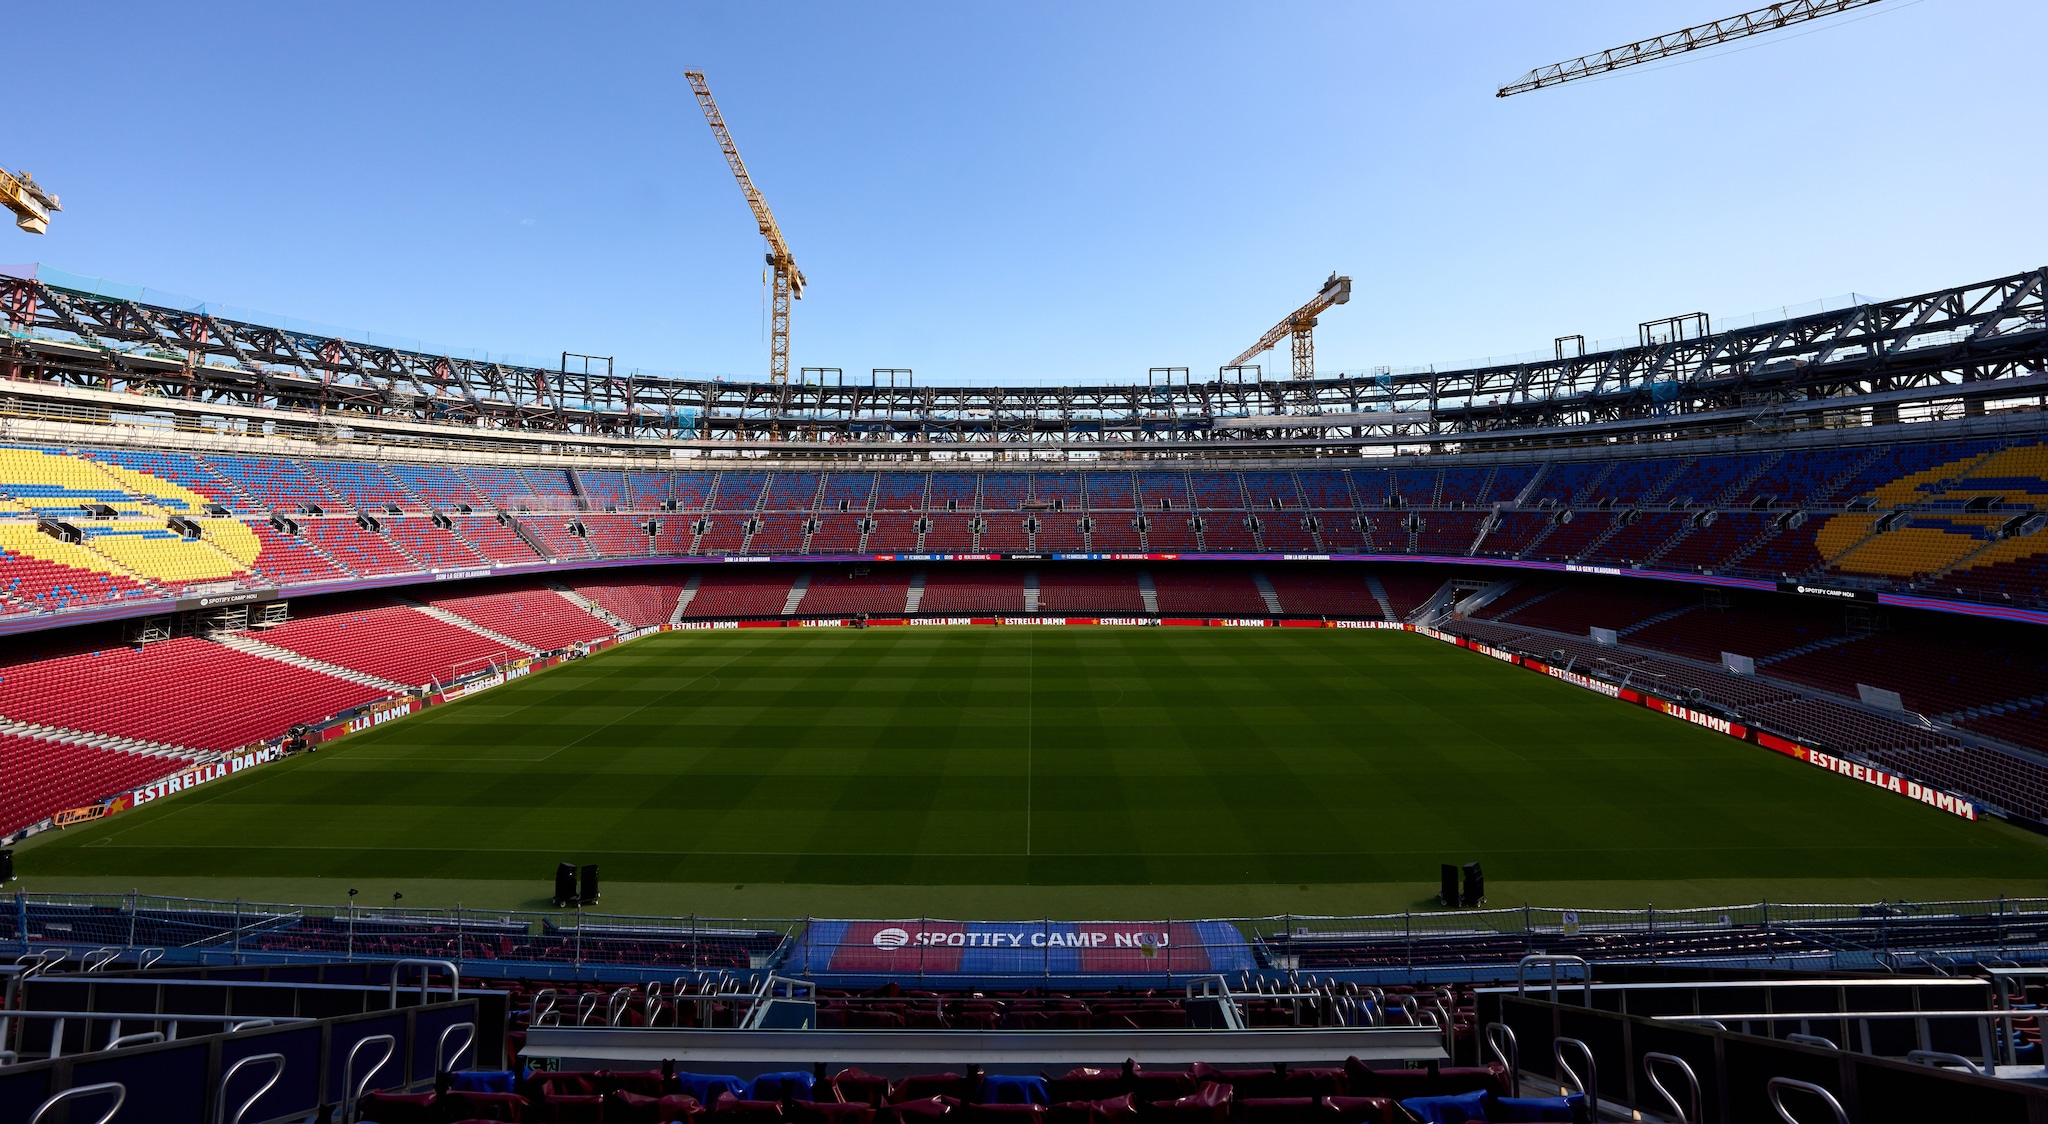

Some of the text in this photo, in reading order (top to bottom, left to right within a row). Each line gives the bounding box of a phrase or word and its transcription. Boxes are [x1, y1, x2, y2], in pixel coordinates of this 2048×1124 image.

[618, 625, 660, 644] ESTRELLA DAMM
[672, 622, 711, 630] ESTRELLA
[1377, 621, 1404, 630] DAMM
[1415, 626, 1456, 644] ESTRELLA DAMM
[1491, 648, 1512, 662] DAMM
[506, 665, 530, 681] DAMM
[1549, 667, 1619, 698] ESTRELLA DAMM
[374, 703, 410, 725] DAMM
[1690, 710, 1730, 734] DAMM
[133, 762, 227, 807] ESTRELLA
[1809, 749, 1974, 821] ESTRELLA DAMM
[914, 932, 1024, 947] SPOTIFY
[1031, 932, 1107, 947] CAMP
